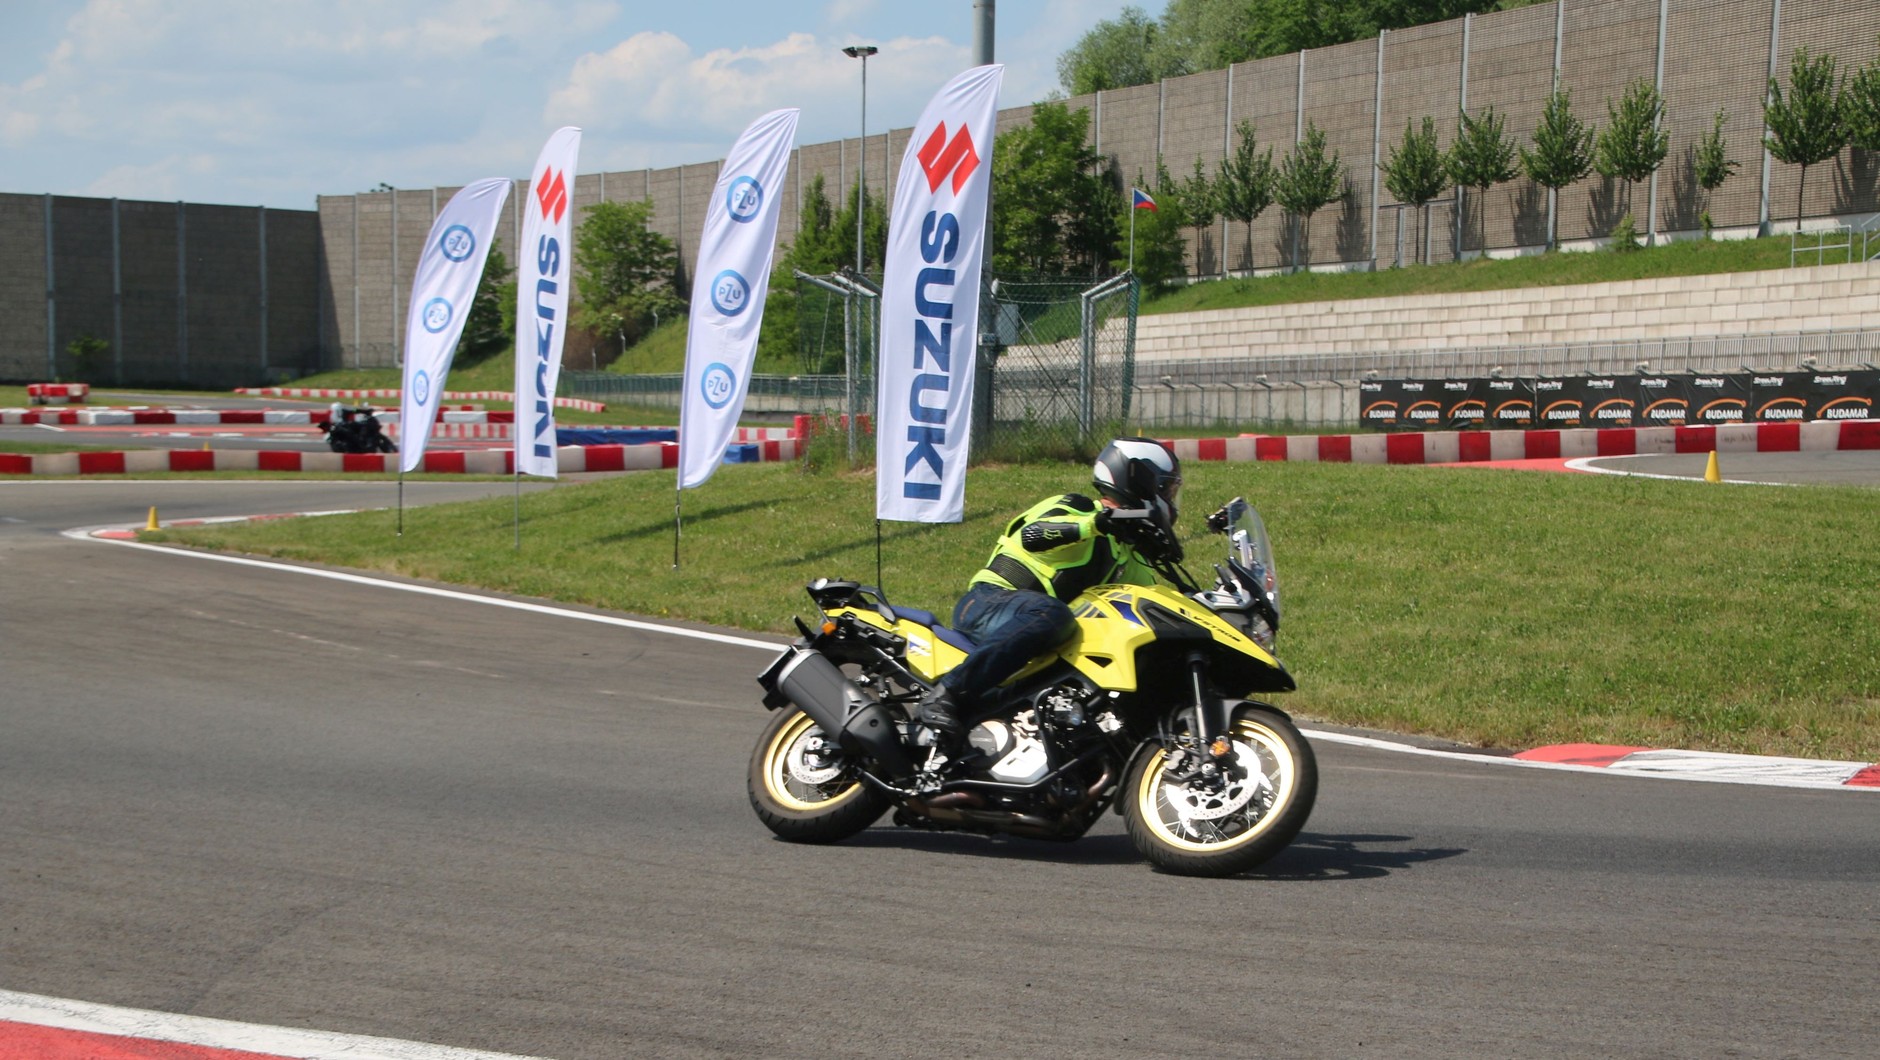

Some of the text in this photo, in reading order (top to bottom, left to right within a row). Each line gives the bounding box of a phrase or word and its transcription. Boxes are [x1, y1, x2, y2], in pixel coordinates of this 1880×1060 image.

[735, 190, 755, 209] PZU
[719, 283, 741, 303] PZU
[534, 234, 560, 458] SUZUKI
[903, 210, 959, 501] SUZUKI
[708, 376, 728, 396] PZU
[1369, 410, 1396, 418] BUDAMAR
[1411, 410, 1439, 419] BUDAMAR
[1500, 410, 1530, 419] BUDAMAR
[1548, 410, 1580, 419] BUDAMAR
[1598, 410, 1632, 419] BUDAMAR
[1651, 409, 1686, 419] BUDAMAR
[1706, 409, 1743, 419] BUDAMAR
[1765, 409, 1803, 419] BUDAMAR
[1827, 408, 1868, 419] BUDAMAR
